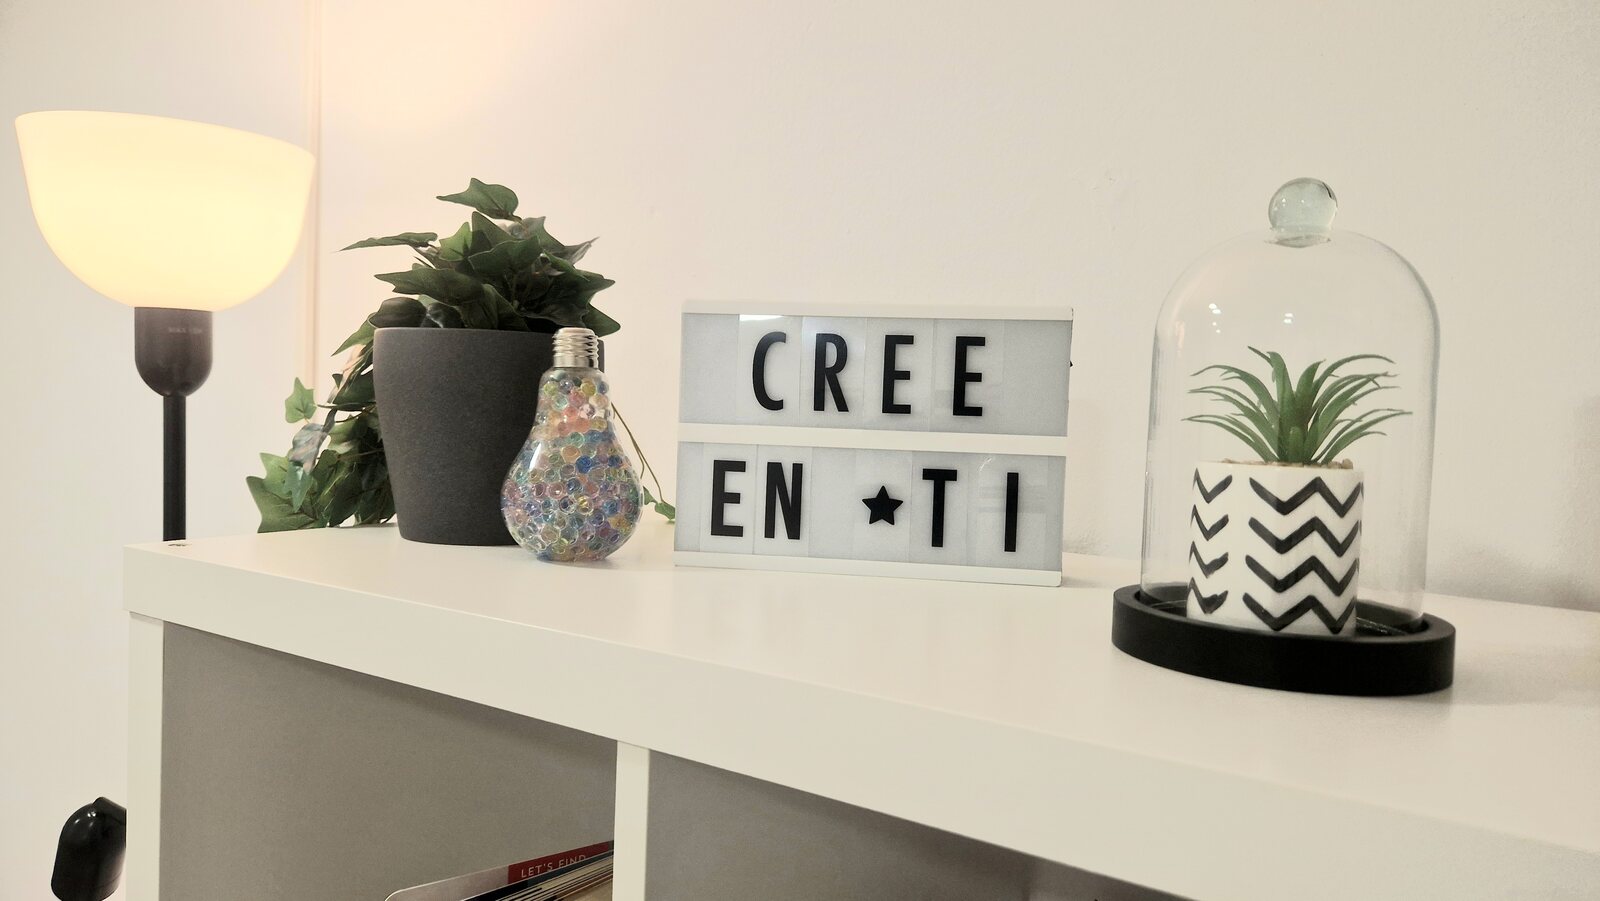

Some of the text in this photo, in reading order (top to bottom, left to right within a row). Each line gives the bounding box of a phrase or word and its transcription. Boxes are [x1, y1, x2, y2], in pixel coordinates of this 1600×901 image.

[752, 332, 986, 417] CREE
[710, 459, 1020, 552] EN TI
[521, 862, 553, 878] LET'S
